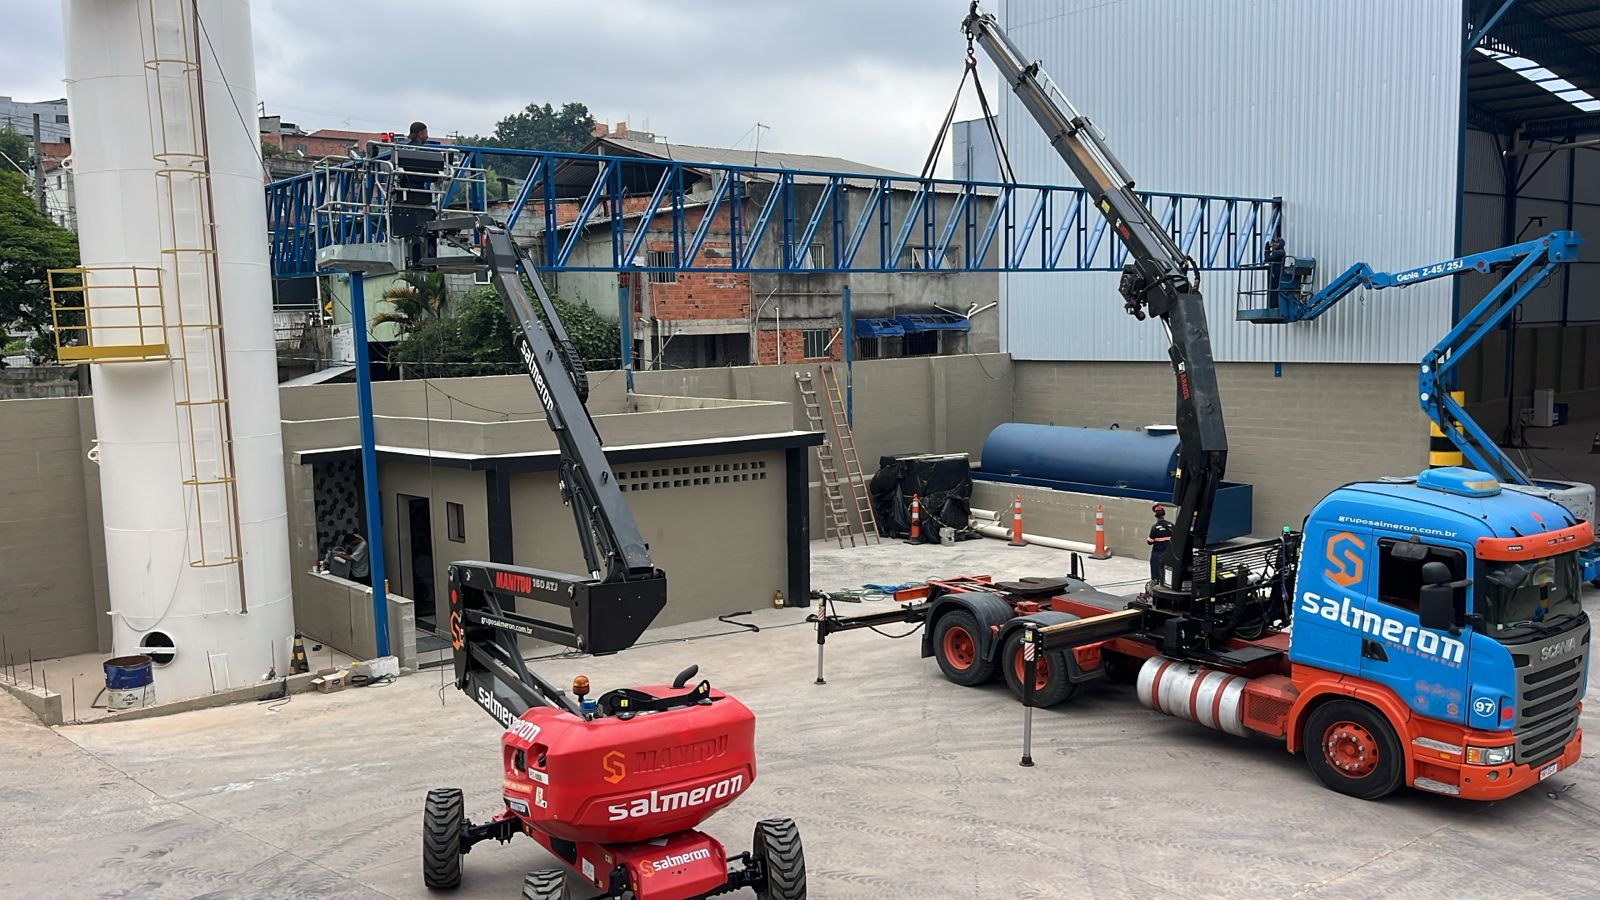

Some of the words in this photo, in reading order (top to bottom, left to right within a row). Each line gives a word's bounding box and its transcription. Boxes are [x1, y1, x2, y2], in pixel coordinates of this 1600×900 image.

[1396, 272, 1419, 282] Genie
[520, 339, 554, 411] salmeron
[1338, 515, 1457, 537] gruposalmeron.com.br
[496, 571, 532, 594] MANITOU
[545, 581, 558, 592] ATJ
[1301, 591, 1464, 664] salmeron
[1541, 637, 1576, 661] SCANIA
[1475, 700, 1495, 713] 97
[633, 734, 729, 774] MANITOU
[608, 774, 743, 821] salmeron
[652, 848, 710, 872] salmeron
